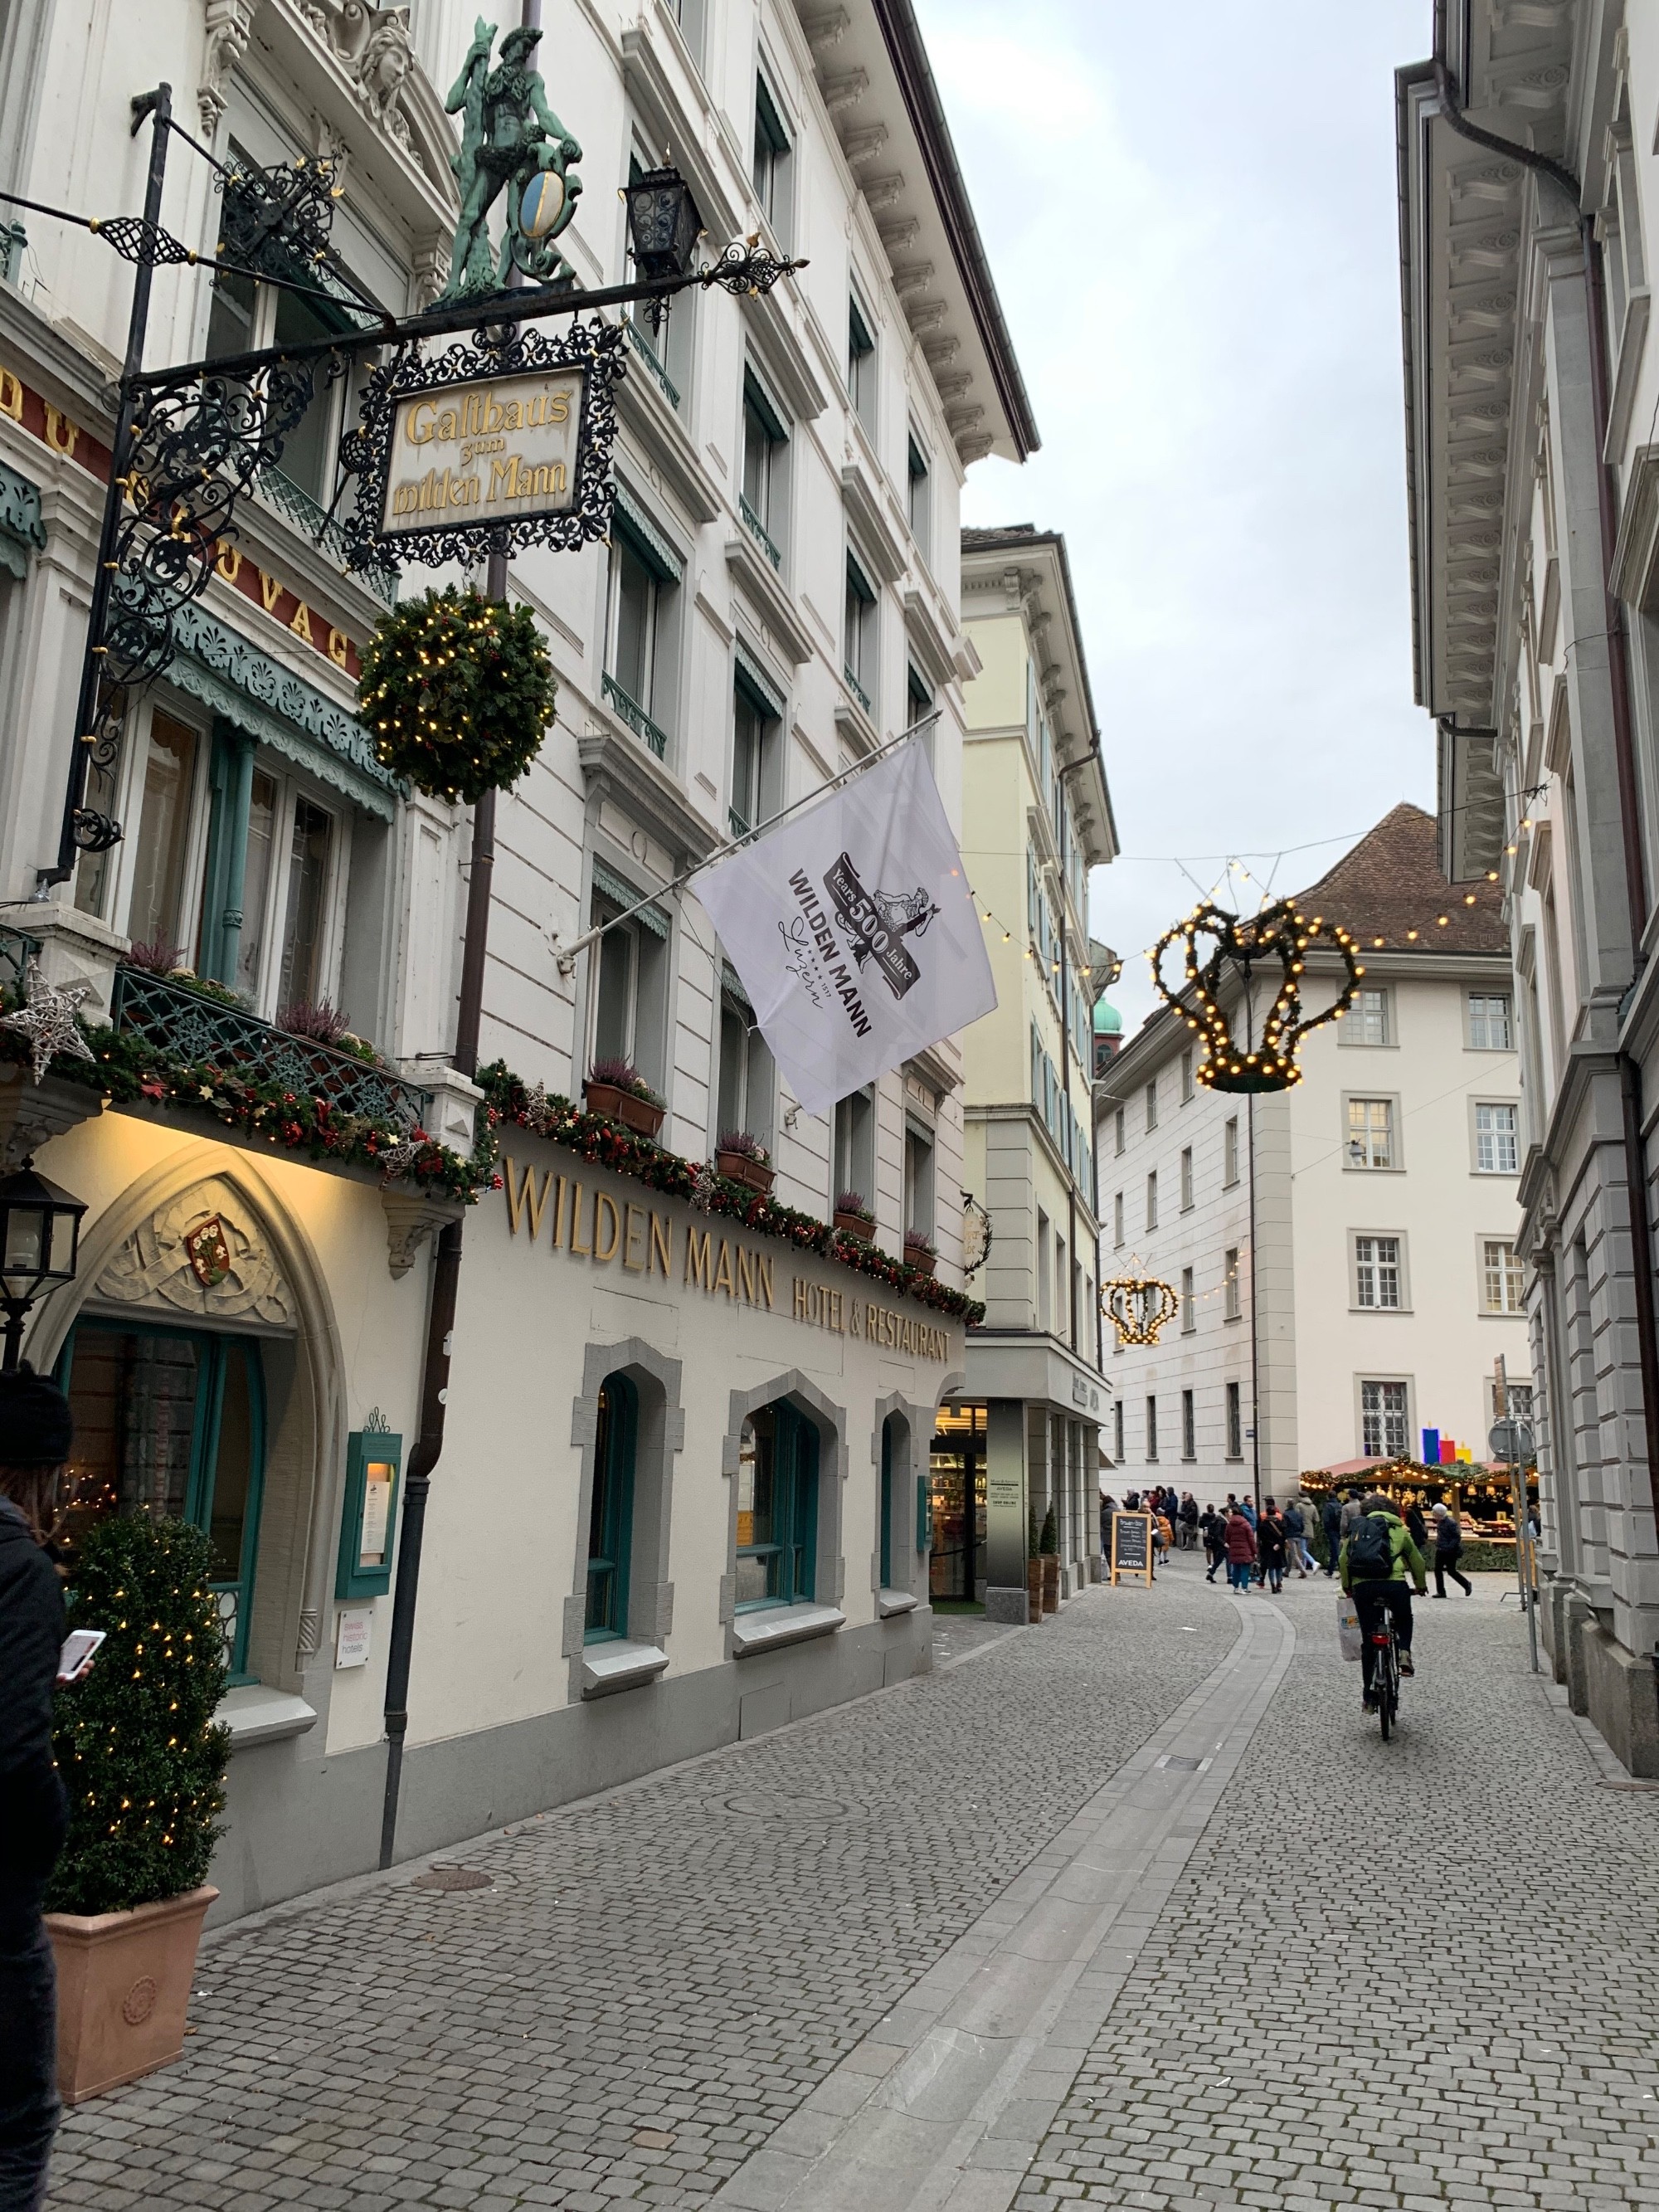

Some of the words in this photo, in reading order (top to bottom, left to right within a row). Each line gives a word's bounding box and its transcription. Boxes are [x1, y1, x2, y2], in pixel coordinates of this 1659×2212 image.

[461, 437, 505, 466] zum
[392, 466, 480, 515] wilden
[486, 456, 567, 502] Mann
[832, 868, 857, 903] Years
[849, 898, 889, 954] 500
[886, 948, 912, 980] Jahre
[778, 916, 823, 1009] Luzern
[788, 868, 840, 962] WILDEN
[829, 963, 872, 1038] MANN
[820, 982, 831, 997] 1517
[505, 1155, 673, 1279] WILDEN
[684, 1225, 774, 1308] MANN
[792, 1276, 849, 1331] HOTEL
[850, 1298, 862, 1335] &
[866, 1303, 951, 1362] RESTAURANT
[1118, 1559, 1144, 1567] AVEDA
[342, 1644, 363, 1654] hotels
[343, 1631, 367, 1643] historic
